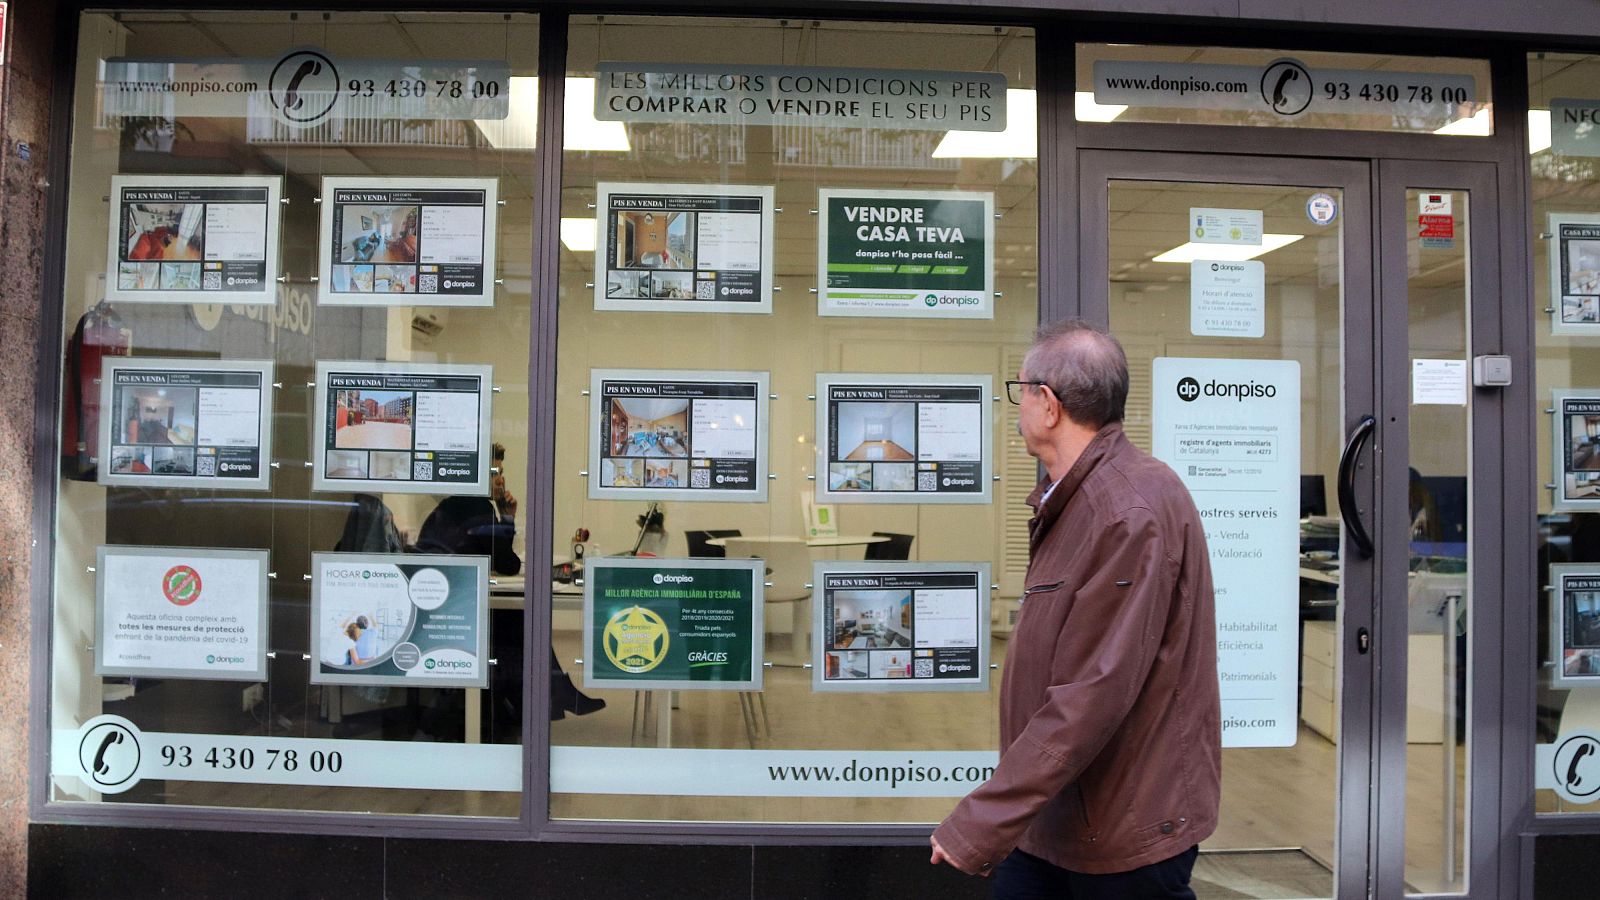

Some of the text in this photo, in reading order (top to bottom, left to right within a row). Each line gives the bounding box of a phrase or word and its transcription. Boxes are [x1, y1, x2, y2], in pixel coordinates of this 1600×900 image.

[118, 78, 258, 97] www.donpiso.com
[348, 79, 499, 98] 93 430 78 00
[611, 72, 992, 99] LES MILLORS CONDICIONS PER
[1106, 74, 1248, 97] www.donpiso.com
[1324, 82, 1467, 105] 93 430 78 00
[609, 95, 992, 122] COMPRAR O VENDRE EL SEU PIS
[844, 206, 924, 223] VENDRE
[857, 226, 965, 243] CASA TEVA
[856, 250, 889, 259] donpiso
[892, 250, 909, 258] t'ho
[934, 251, 953, 259] fàcil
[730, 287, 753, 295] donpiso
[940, 295, 979, 307] donpiso
[1180, 379, 1276, 402] dp donpiso
[1189, 447, 1219, 455] Catalunya
[229, 463, 251, 471] donpiso
[447, 468, 470, 477] donpiso
[724, 475, 749, 483] donpiso
[950, 478, 974, 486] donpiso
[1201, 507, 1278, 519] ostres serveis
[1220, 530, 1249, 540] Venda
[1218, 549, 1262, 558] Valoració
[327, 570, 360, 578] HOGAR
[664, 575, 694, 584] donpiso
[605, 589, 741, 599] MILLOR AGÈNCIA IMMOBILIÀRIA D'ESPAÑA
[126, 613, 156, 622] Aquesta
[159, 614, 182, 622] oficina
[185, 614, 218, 623] compleix
[206, 625, 245, 633] protecció
[1219, 622, 1278, 632] Habitabilitat
[164, 634, 200, 643] pandèmia
[1218, 641, 1264, 650] Eficiència
[216, 655, 245, 664] donpiso
[688, 651, 728, 661] GRÀCIES
[437, 658, 472, 670] donpiso
[948, 664, 971, 672] donpiso
[1221, 672, 1277, 681] Patrimonials
[1223, 716, 1276, 731] piso.com
[161, 744, 342, 774] 93 430 78 00
